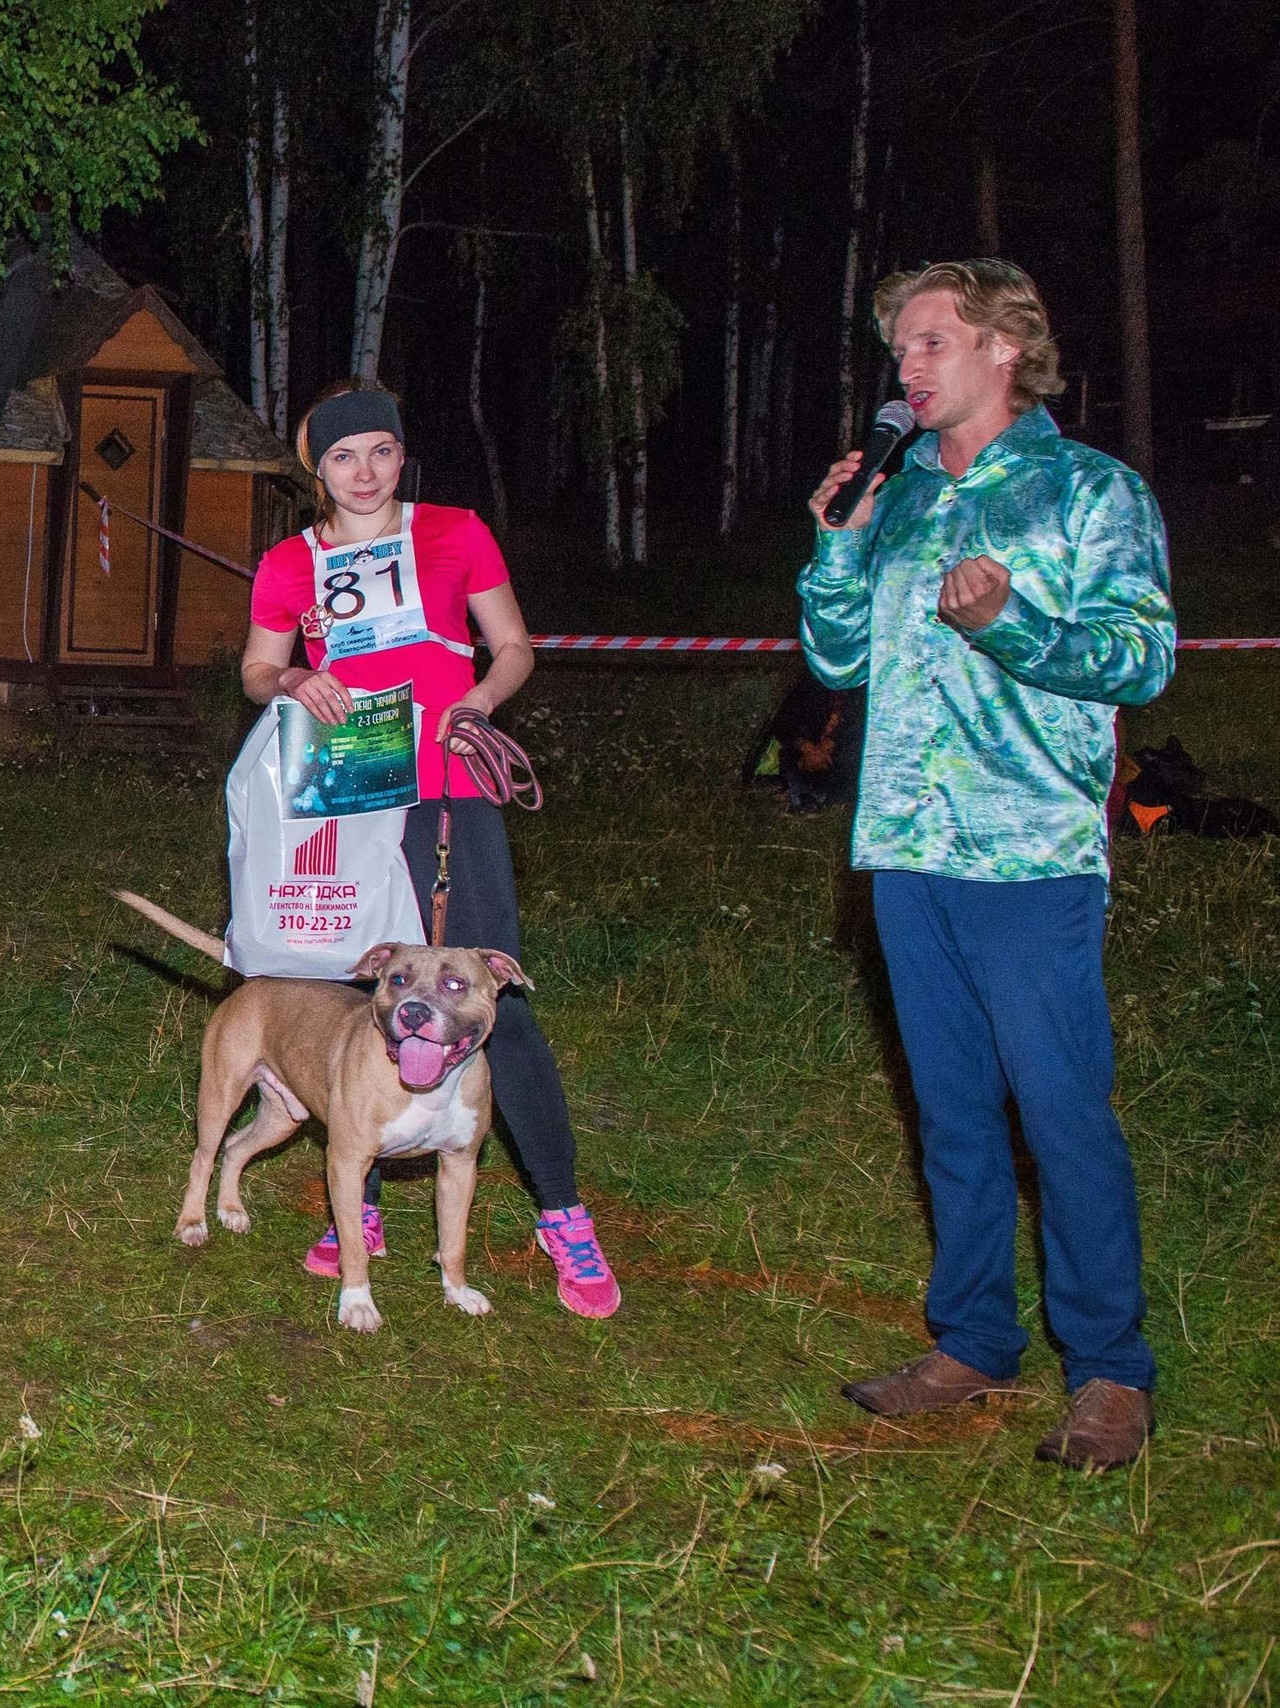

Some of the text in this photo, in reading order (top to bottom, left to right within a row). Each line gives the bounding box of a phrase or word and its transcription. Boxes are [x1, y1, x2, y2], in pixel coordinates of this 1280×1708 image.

[323, 559, 405, 620] 81
[357, 708, 400, 727] 2-3 СЕНТЯБРЯ
[269, 902, 304, 910] АГЕНТСТВО
[278, 915, 352, 931] 310-22-22
